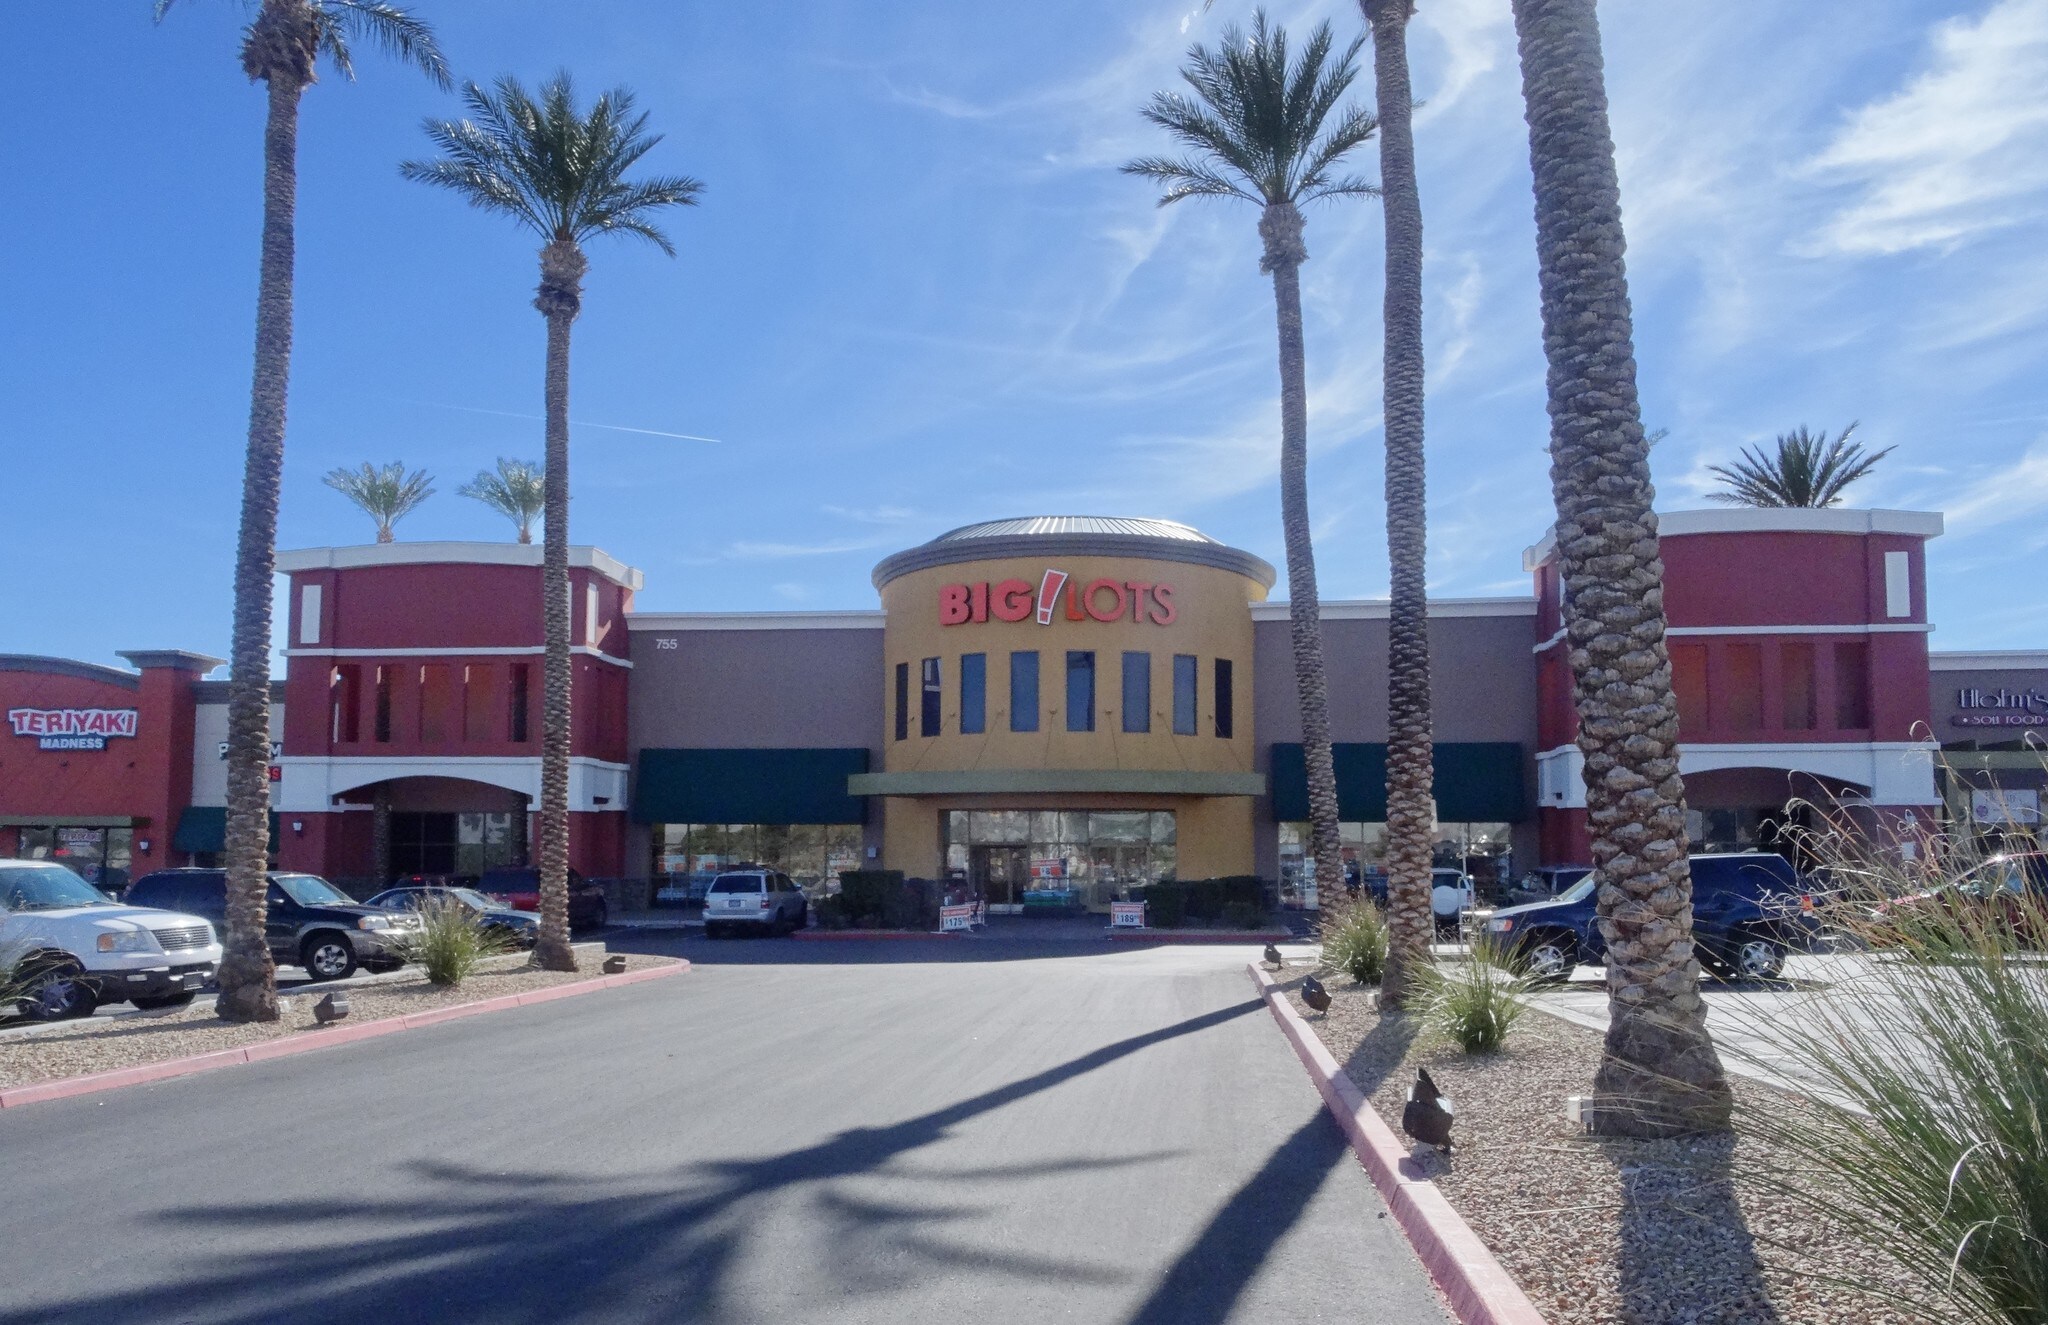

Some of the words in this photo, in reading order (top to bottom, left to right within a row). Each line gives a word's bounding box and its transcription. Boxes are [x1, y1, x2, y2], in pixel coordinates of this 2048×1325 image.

[1066, 577, 1178, 626] LOTS
[656, 638, 678, 650] 755
[9, 708, 138, 736] TERIYAKI
[40, 738, 103, 749] MADNESS
